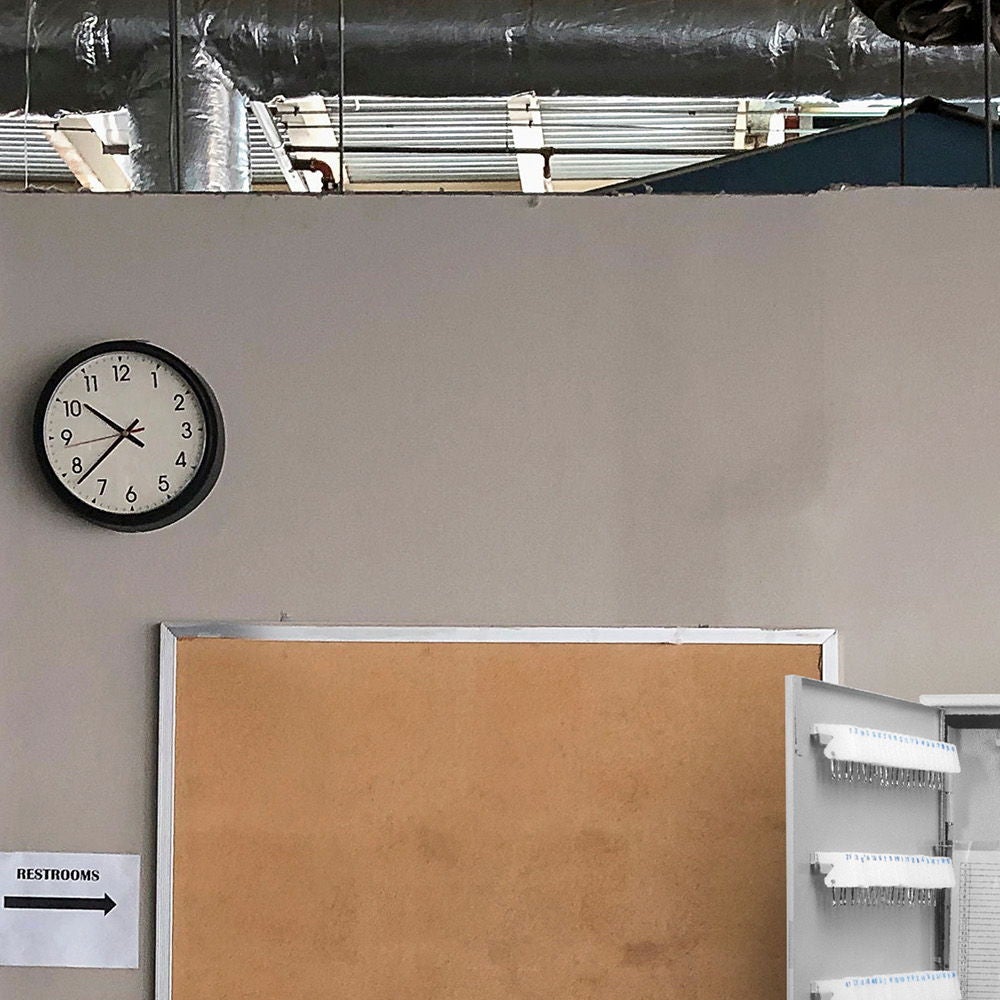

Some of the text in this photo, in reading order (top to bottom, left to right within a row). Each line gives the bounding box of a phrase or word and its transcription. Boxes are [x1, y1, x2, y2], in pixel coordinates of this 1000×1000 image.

[112, 364, 131, 382] 12
[150, 371, 158, 389] 1
[83, 375, 98, 393] 11
[62, 400, 82, 417] 10
[173, 394, 185, 411] 2
[60, 429, 73, 446] 9
[181, 422, 192, 439] 3
[71, 457, 83, 474] 8
[175, 451, 187, 468] 4
[97, 478, 108, 496] 7
[158, 475, 169, 492] 5
[125, 485, 137, 503] 6
[16, 868, 100, 881] RESTROOMS
